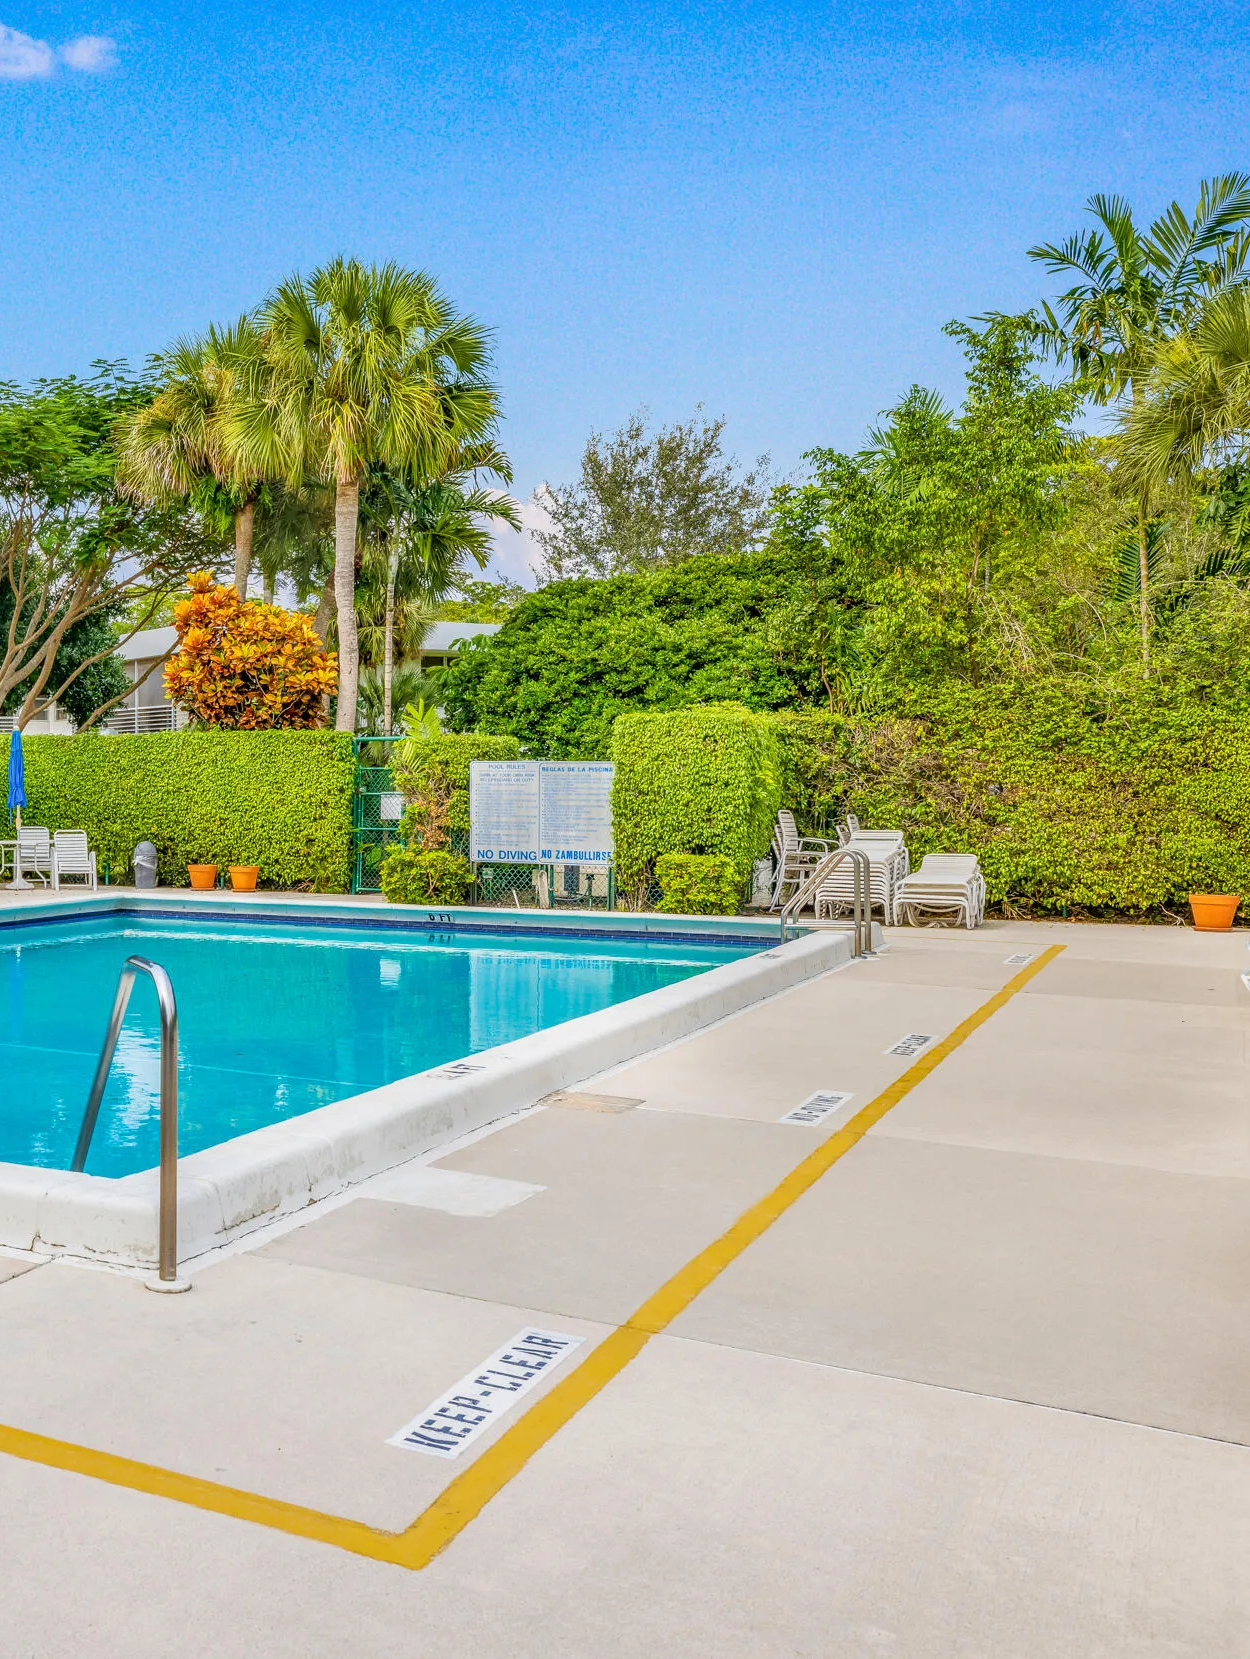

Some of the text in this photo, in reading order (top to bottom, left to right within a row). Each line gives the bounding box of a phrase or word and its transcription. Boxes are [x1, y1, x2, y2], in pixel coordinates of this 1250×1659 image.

[477, 849, 537, 861] NO DIVING
[541, 849, 552, 859] NO
[439, 913, 452, 922] FT
[403, 1335, 570, 1452] KEEP-CLEAR
